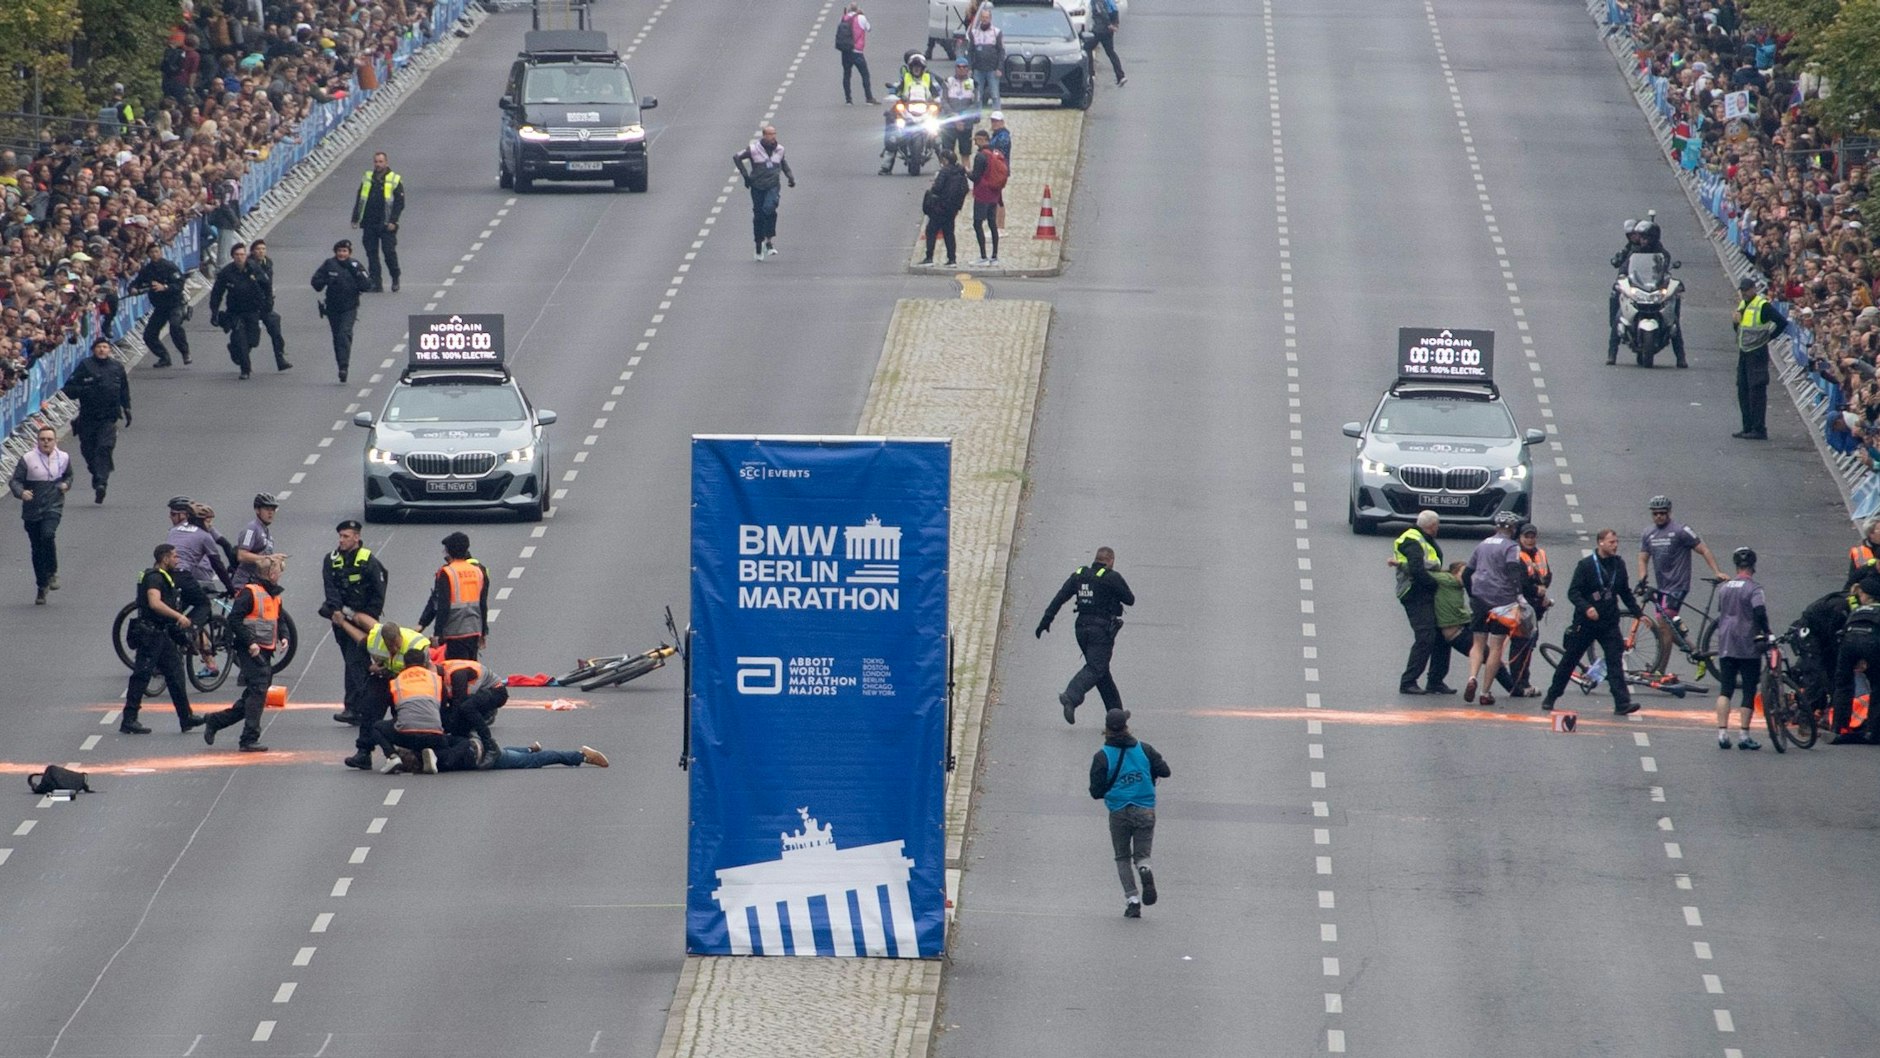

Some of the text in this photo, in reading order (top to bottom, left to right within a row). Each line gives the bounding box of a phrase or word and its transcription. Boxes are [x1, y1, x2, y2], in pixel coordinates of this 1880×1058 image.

[430, 324, 482, 332] NORQAIN
[420, 333, 491, 350] 00:00:00
[1420, 338, 1472, 347] NORQAIN
[416, 352, 431, 360] THE
[442, 352, 461, 360] 100%
[462, 351, 497, 360] ELECTRIC.
[1410, 347, 1480, 366] 00:00:00
[1405, 365, 1419, 373] THE
[1430, 365, 1450, 375] 100%
[1451, 366, 1486, 376] ELECTRIC.
[768, 469, 810, 478] EVENTS
[1423, 495, 1439, 504] THE
[1440, 496, 1458, 504] NEW
[739, 524, 838, 556] BMW
[739, 560, 838, 583] BERLIN
[738, 587, 899, 610] MARATHON
[789, 657, 835, 667] ABBOTT
[789, 666, 831, 676] WORLD
[788, 676, 857, 686] MARATHON
[788, 685, 838, 696] MAJORS
[879, 689, 896, 697] YORK
